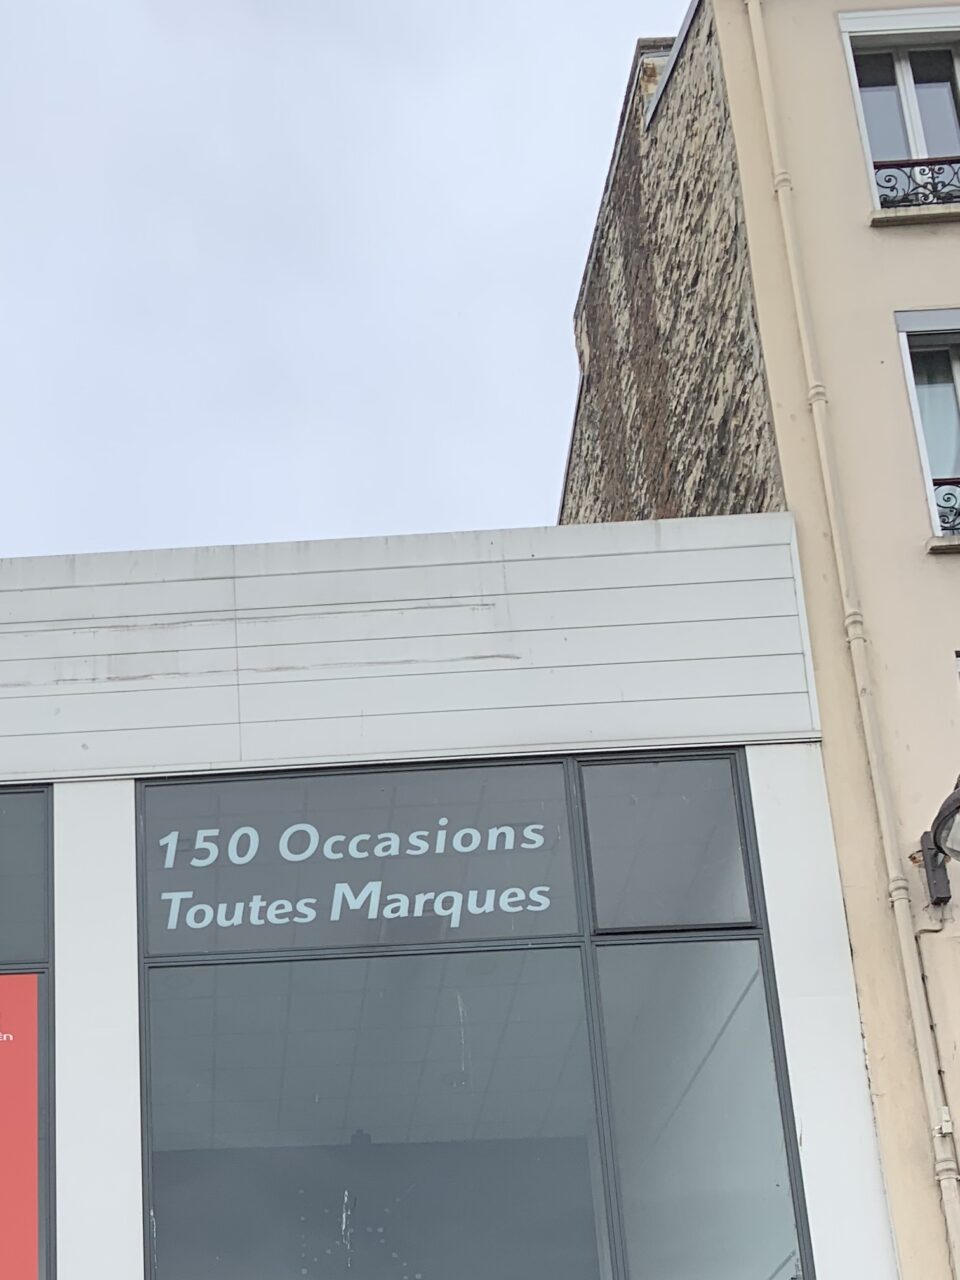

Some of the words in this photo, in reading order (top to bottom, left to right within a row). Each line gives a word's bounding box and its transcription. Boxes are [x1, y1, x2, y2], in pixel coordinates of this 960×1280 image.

[159, 826, 259, 868] 150
[279, 817, 544, 862] Occasions
[161, 891, 317, 929] Toutes
[331, 880, 550, 927] Marques
